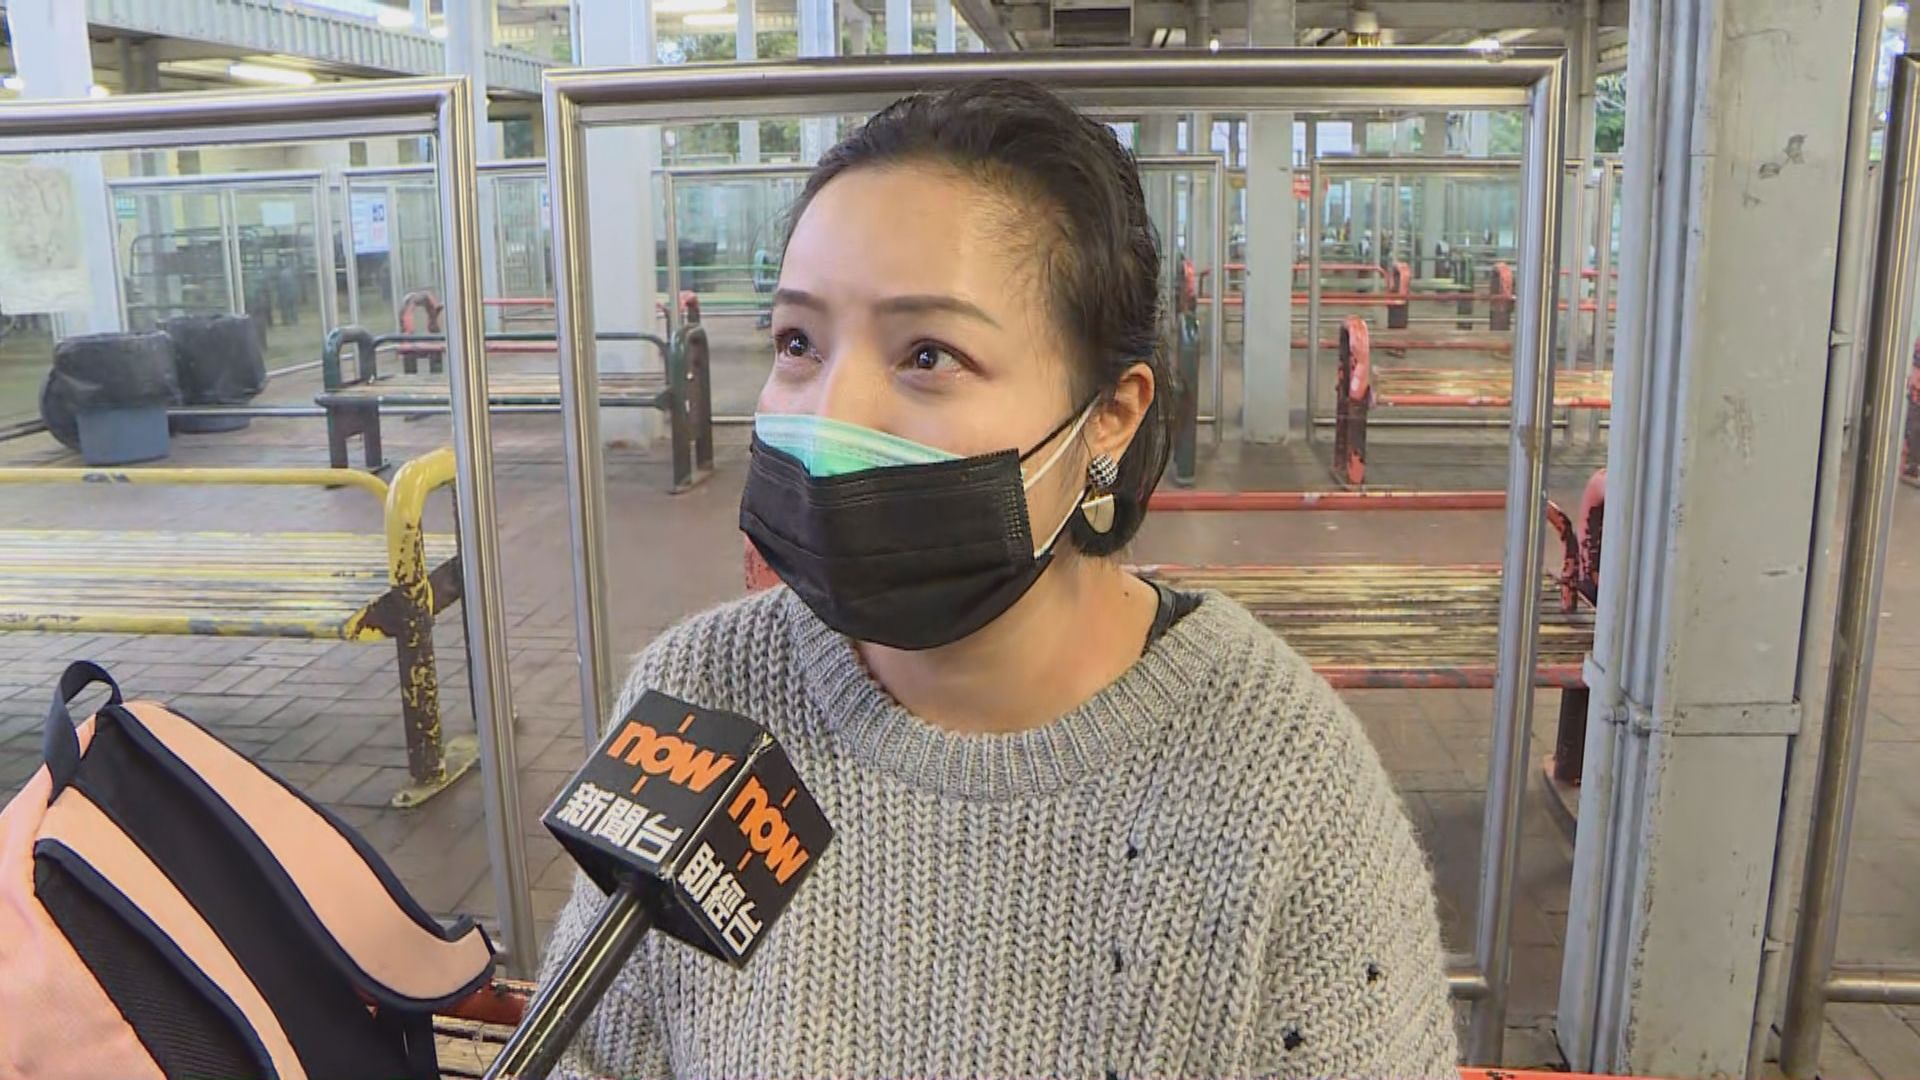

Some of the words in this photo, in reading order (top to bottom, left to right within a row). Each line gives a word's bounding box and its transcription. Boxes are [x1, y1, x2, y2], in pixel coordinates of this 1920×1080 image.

[608, 721, 736, 793] now
[555, 782, 683, 864] 新聞台
[728, 776, 809, 885] now
[677, 842, 763, 956] 財經台
